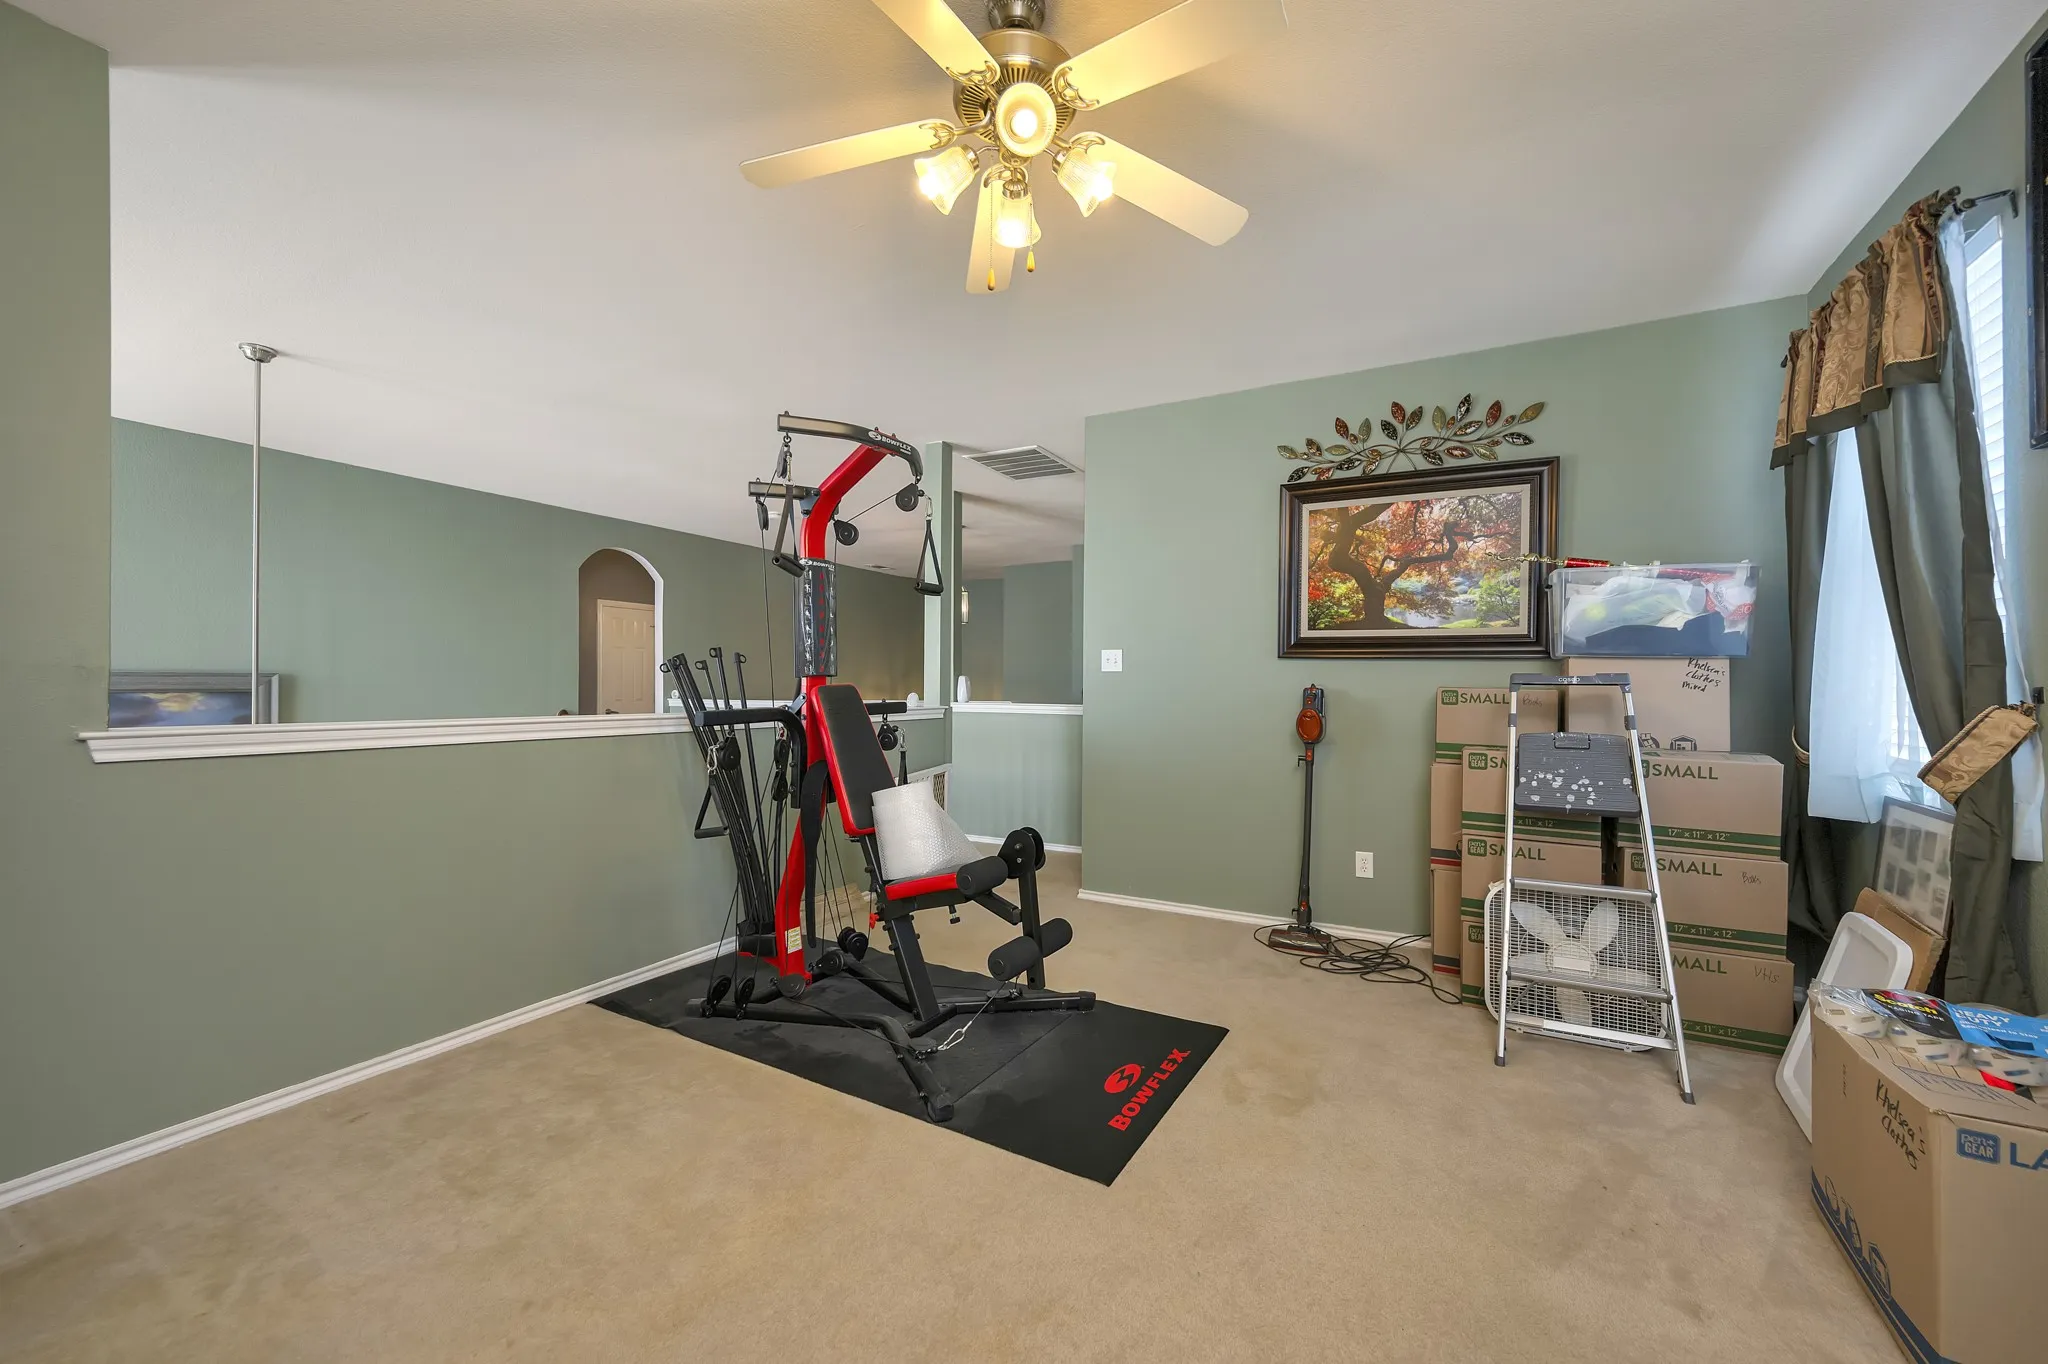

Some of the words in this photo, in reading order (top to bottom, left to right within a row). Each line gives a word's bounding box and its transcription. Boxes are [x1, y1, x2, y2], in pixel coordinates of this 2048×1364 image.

[881, 435, 912, 452] BOWFLEX
[1460, 692, 1509, 704] SMALL
[1652, 764, 1718, 780] SMALL
[1668, 828, 1681, 836] 17"
[1692, 831, 1704, 839] 11"
[1715, 833, 1730, 841] 12"
[1656, 858, 1722, 876] SMALL
[1674, 924, 1688, 932] 17"
[1700, 927, 1711, 935] 11"
[1672, 955, 1727, 974] MALL
[1874, 993, 1938, 1015] Scotch
[1683, 1021, 1693, 1029] 7"
[1704, 1025, 1716, 1033] 11"
[1728, 1028, 1742, 1037] 12"
[1108, 1048, 1191, 1131] BOWFLEX
[1961, 1134, 1995, 1147] pen+
[1964, 1144, 1993, 1159] GEAR
